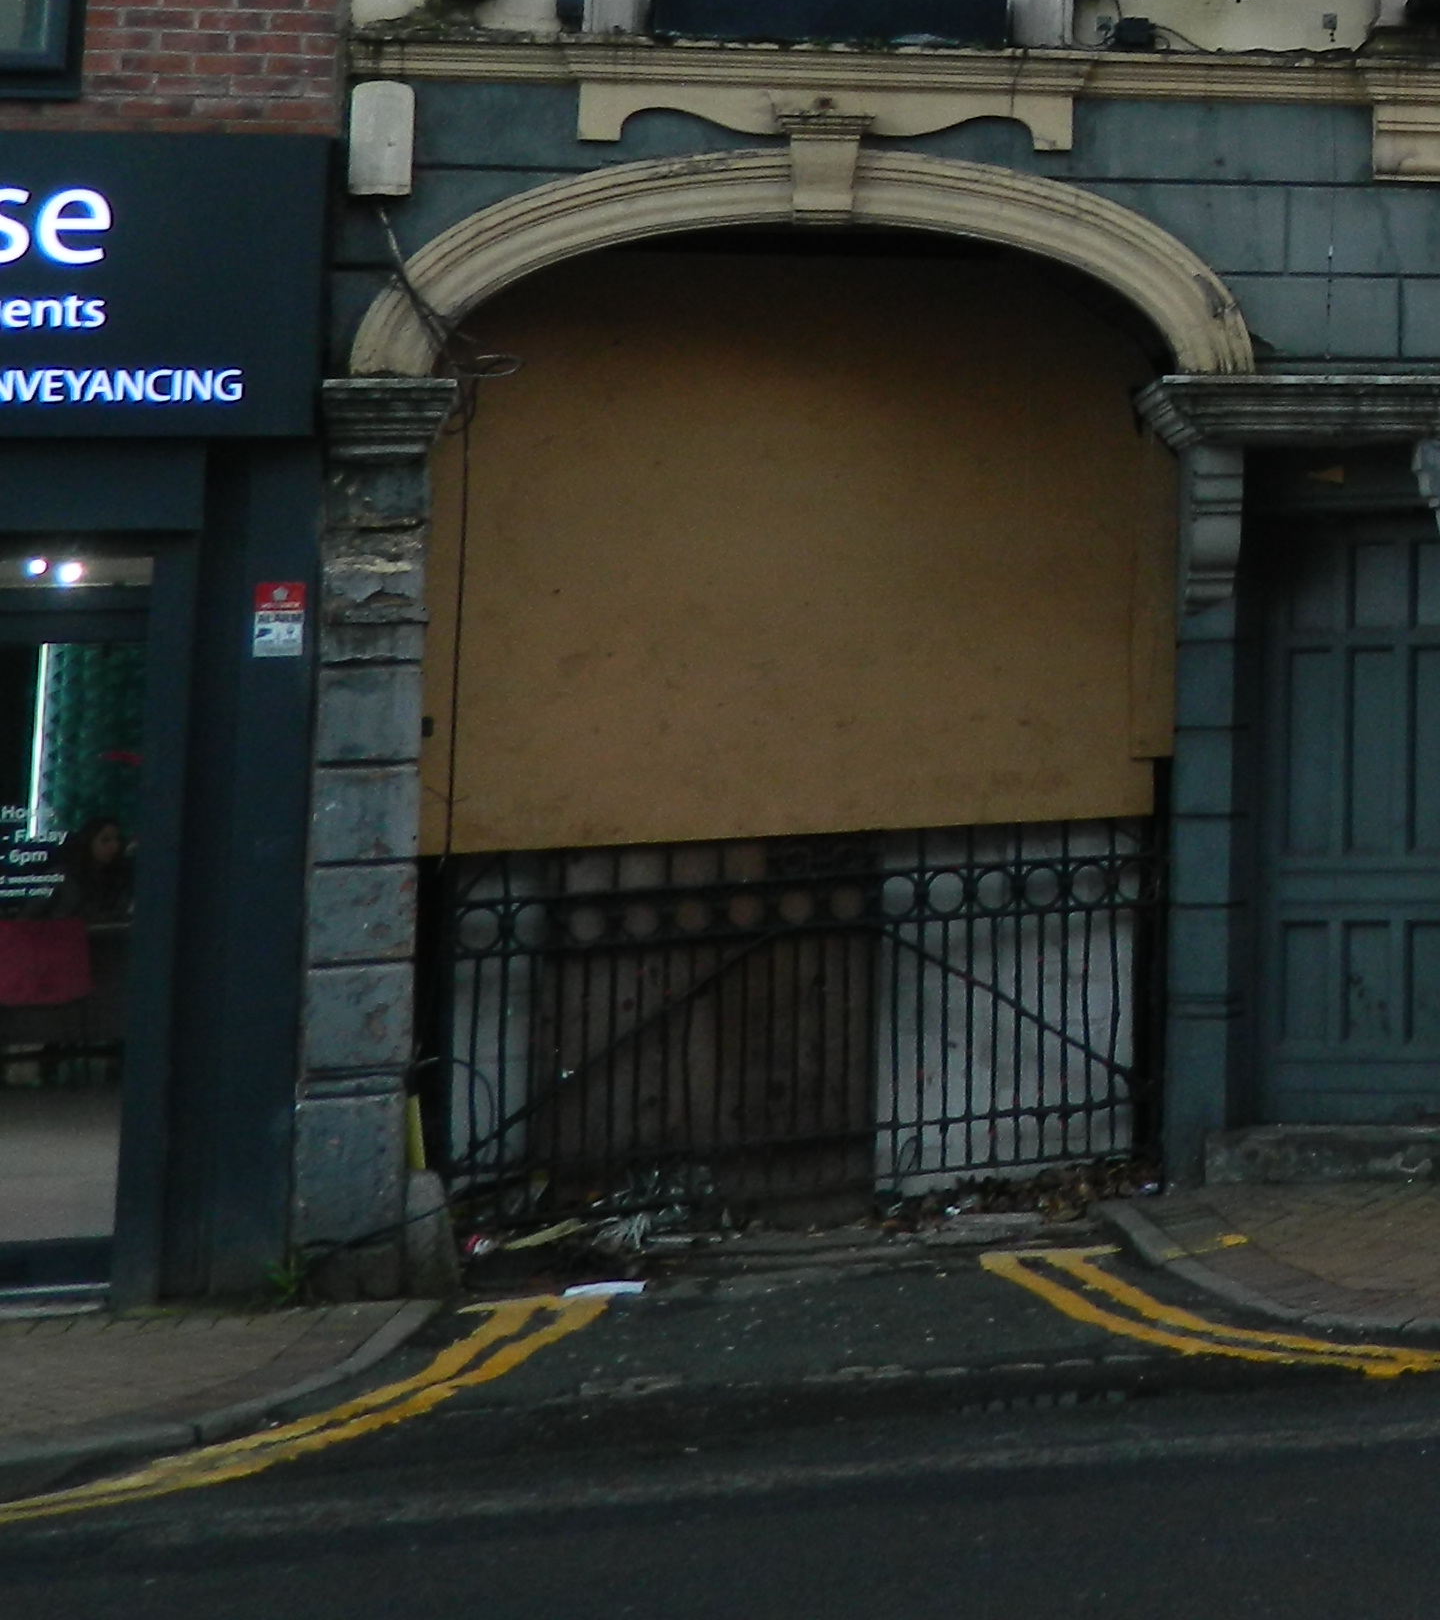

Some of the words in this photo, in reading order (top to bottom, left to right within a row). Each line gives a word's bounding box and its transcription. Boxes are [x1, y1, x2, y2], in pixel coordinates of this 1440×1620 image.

[0, 187, 112, 265] se
[0, 293, 107, 329] ents
[9, 849, 49, 866] 6pm
